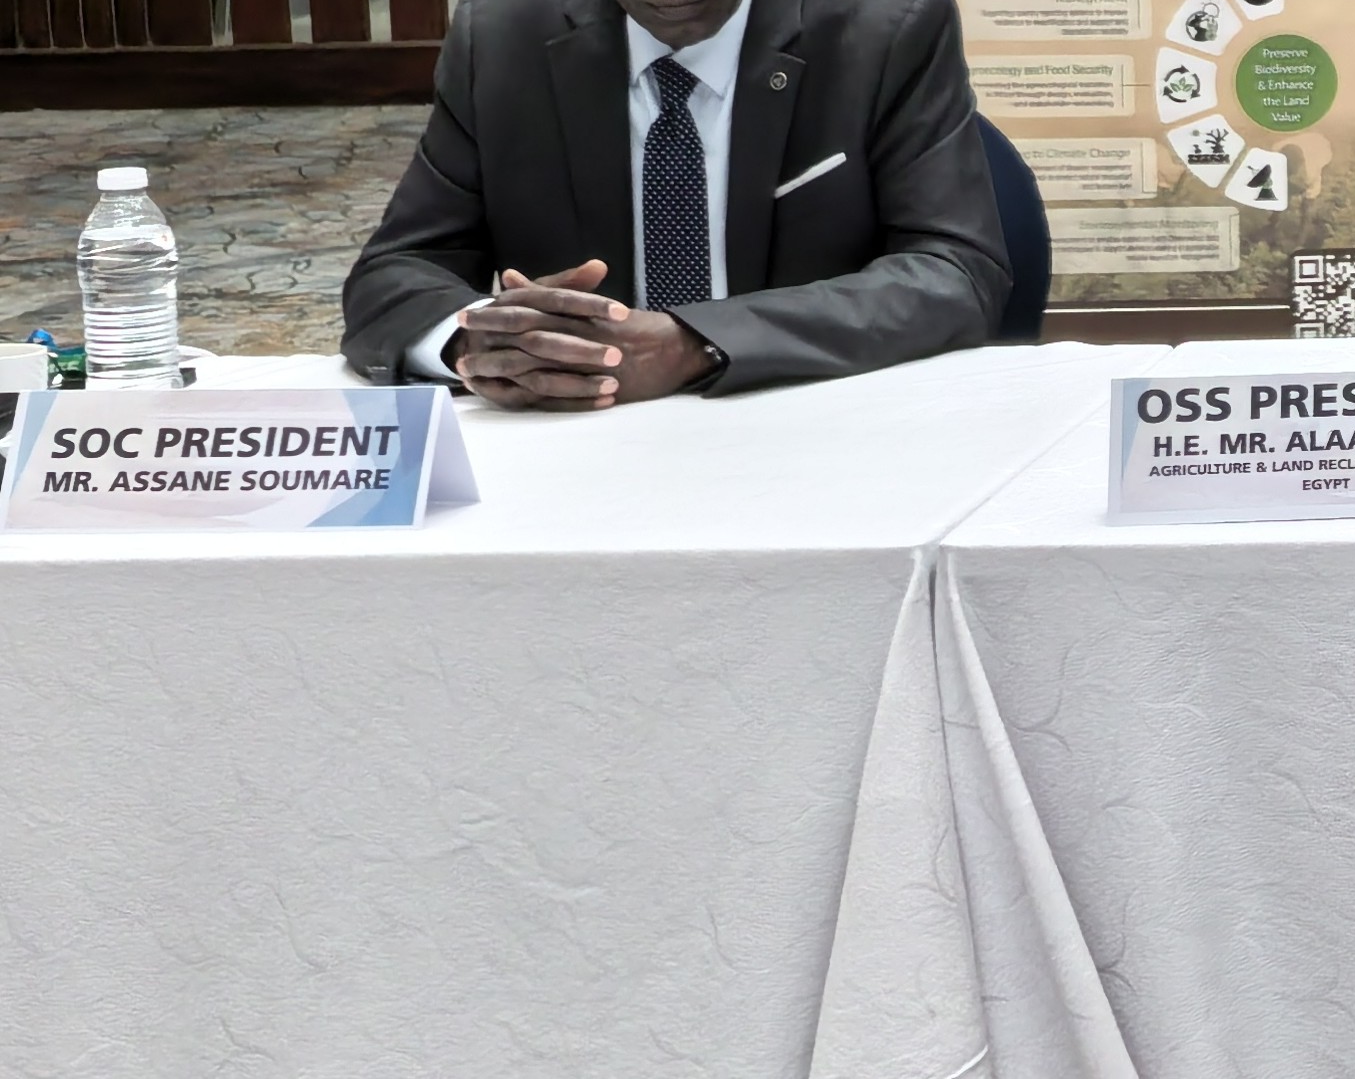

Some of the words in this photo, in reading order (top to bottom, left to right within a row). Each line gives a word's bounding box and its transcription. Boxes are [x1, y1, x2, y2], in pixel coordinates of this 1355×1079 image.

[1263, 49, 1308, 58] Preserve
[1045, 65, 1070, 74] Food
[1255, 64, 1316, 75] Biodiversity
[1258, 81, 1266, 90] &
[1269, 80, 1313, 90] Enhance
[1263, 98, 1281, 106] the
[1283, 95, 1309, 106] Land
[1137, 386, 1232, 423] OSS
[51, 427, 142, 459] SOC
[154, 425, 399, 458] PRESIDENT
[1154, 435, 1208, 457] H.E.
[1220, 433, 1275, 454] MR.
[1149, 462, 1252, 477] AGRICULTURE
[1256, 461, 1268, 473] &
[1272, 459, 1314, 472] LAND
[43, 471, 98, 493] MR.
[109, 470, 230, 492] ASSANE
[239, 468, 391, 491] SOUMARE
[1302, 477, 1351, 490] EGYPT
